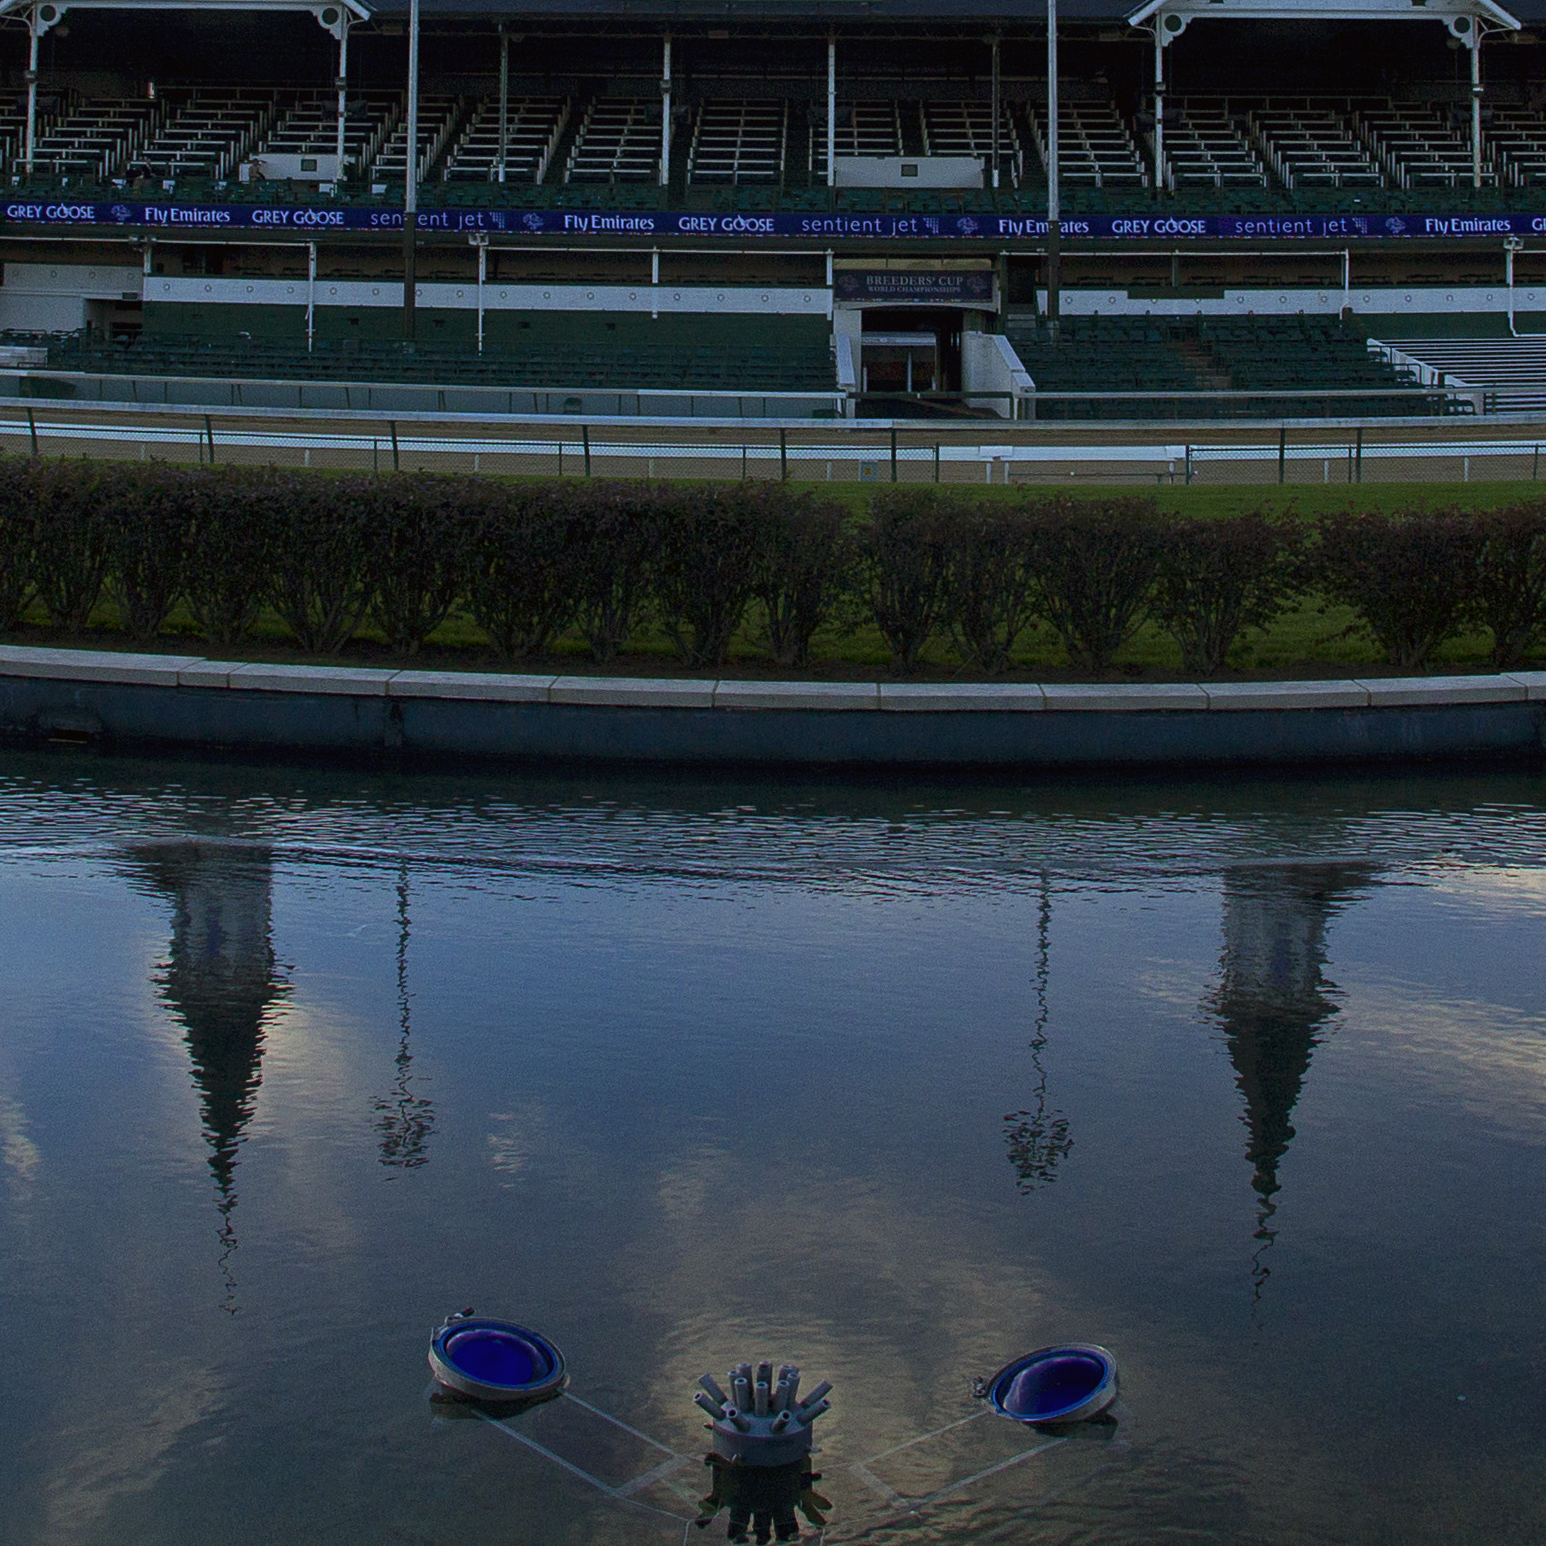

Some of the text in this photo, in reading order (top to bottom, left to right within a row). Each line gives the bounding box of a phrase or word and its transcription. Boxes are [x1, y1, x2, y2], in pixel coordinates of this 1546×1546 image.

[7, 203, 96, 220] GREY GOOSE
[144, 206, 231, 224] Fly Emirates
[252, 208, 345, 225] GREY GOOSE
[370, 212, 485, 230] senent jet
[563, 214, 655, 231] Fly Emirates
[678, 214, 775, 232] GREY GOOSE
[801, 217, 919, 236] sentient jet
[998, 219, 1090, 236] Fly Emates
[1111, 216, 1207, 234] GREY GOOSE
[1234, 218, 1348, 236] sentient jet
[1425, 217, 1512, 234] Fly Emirates
[938, 275, 964, 286] CUP
